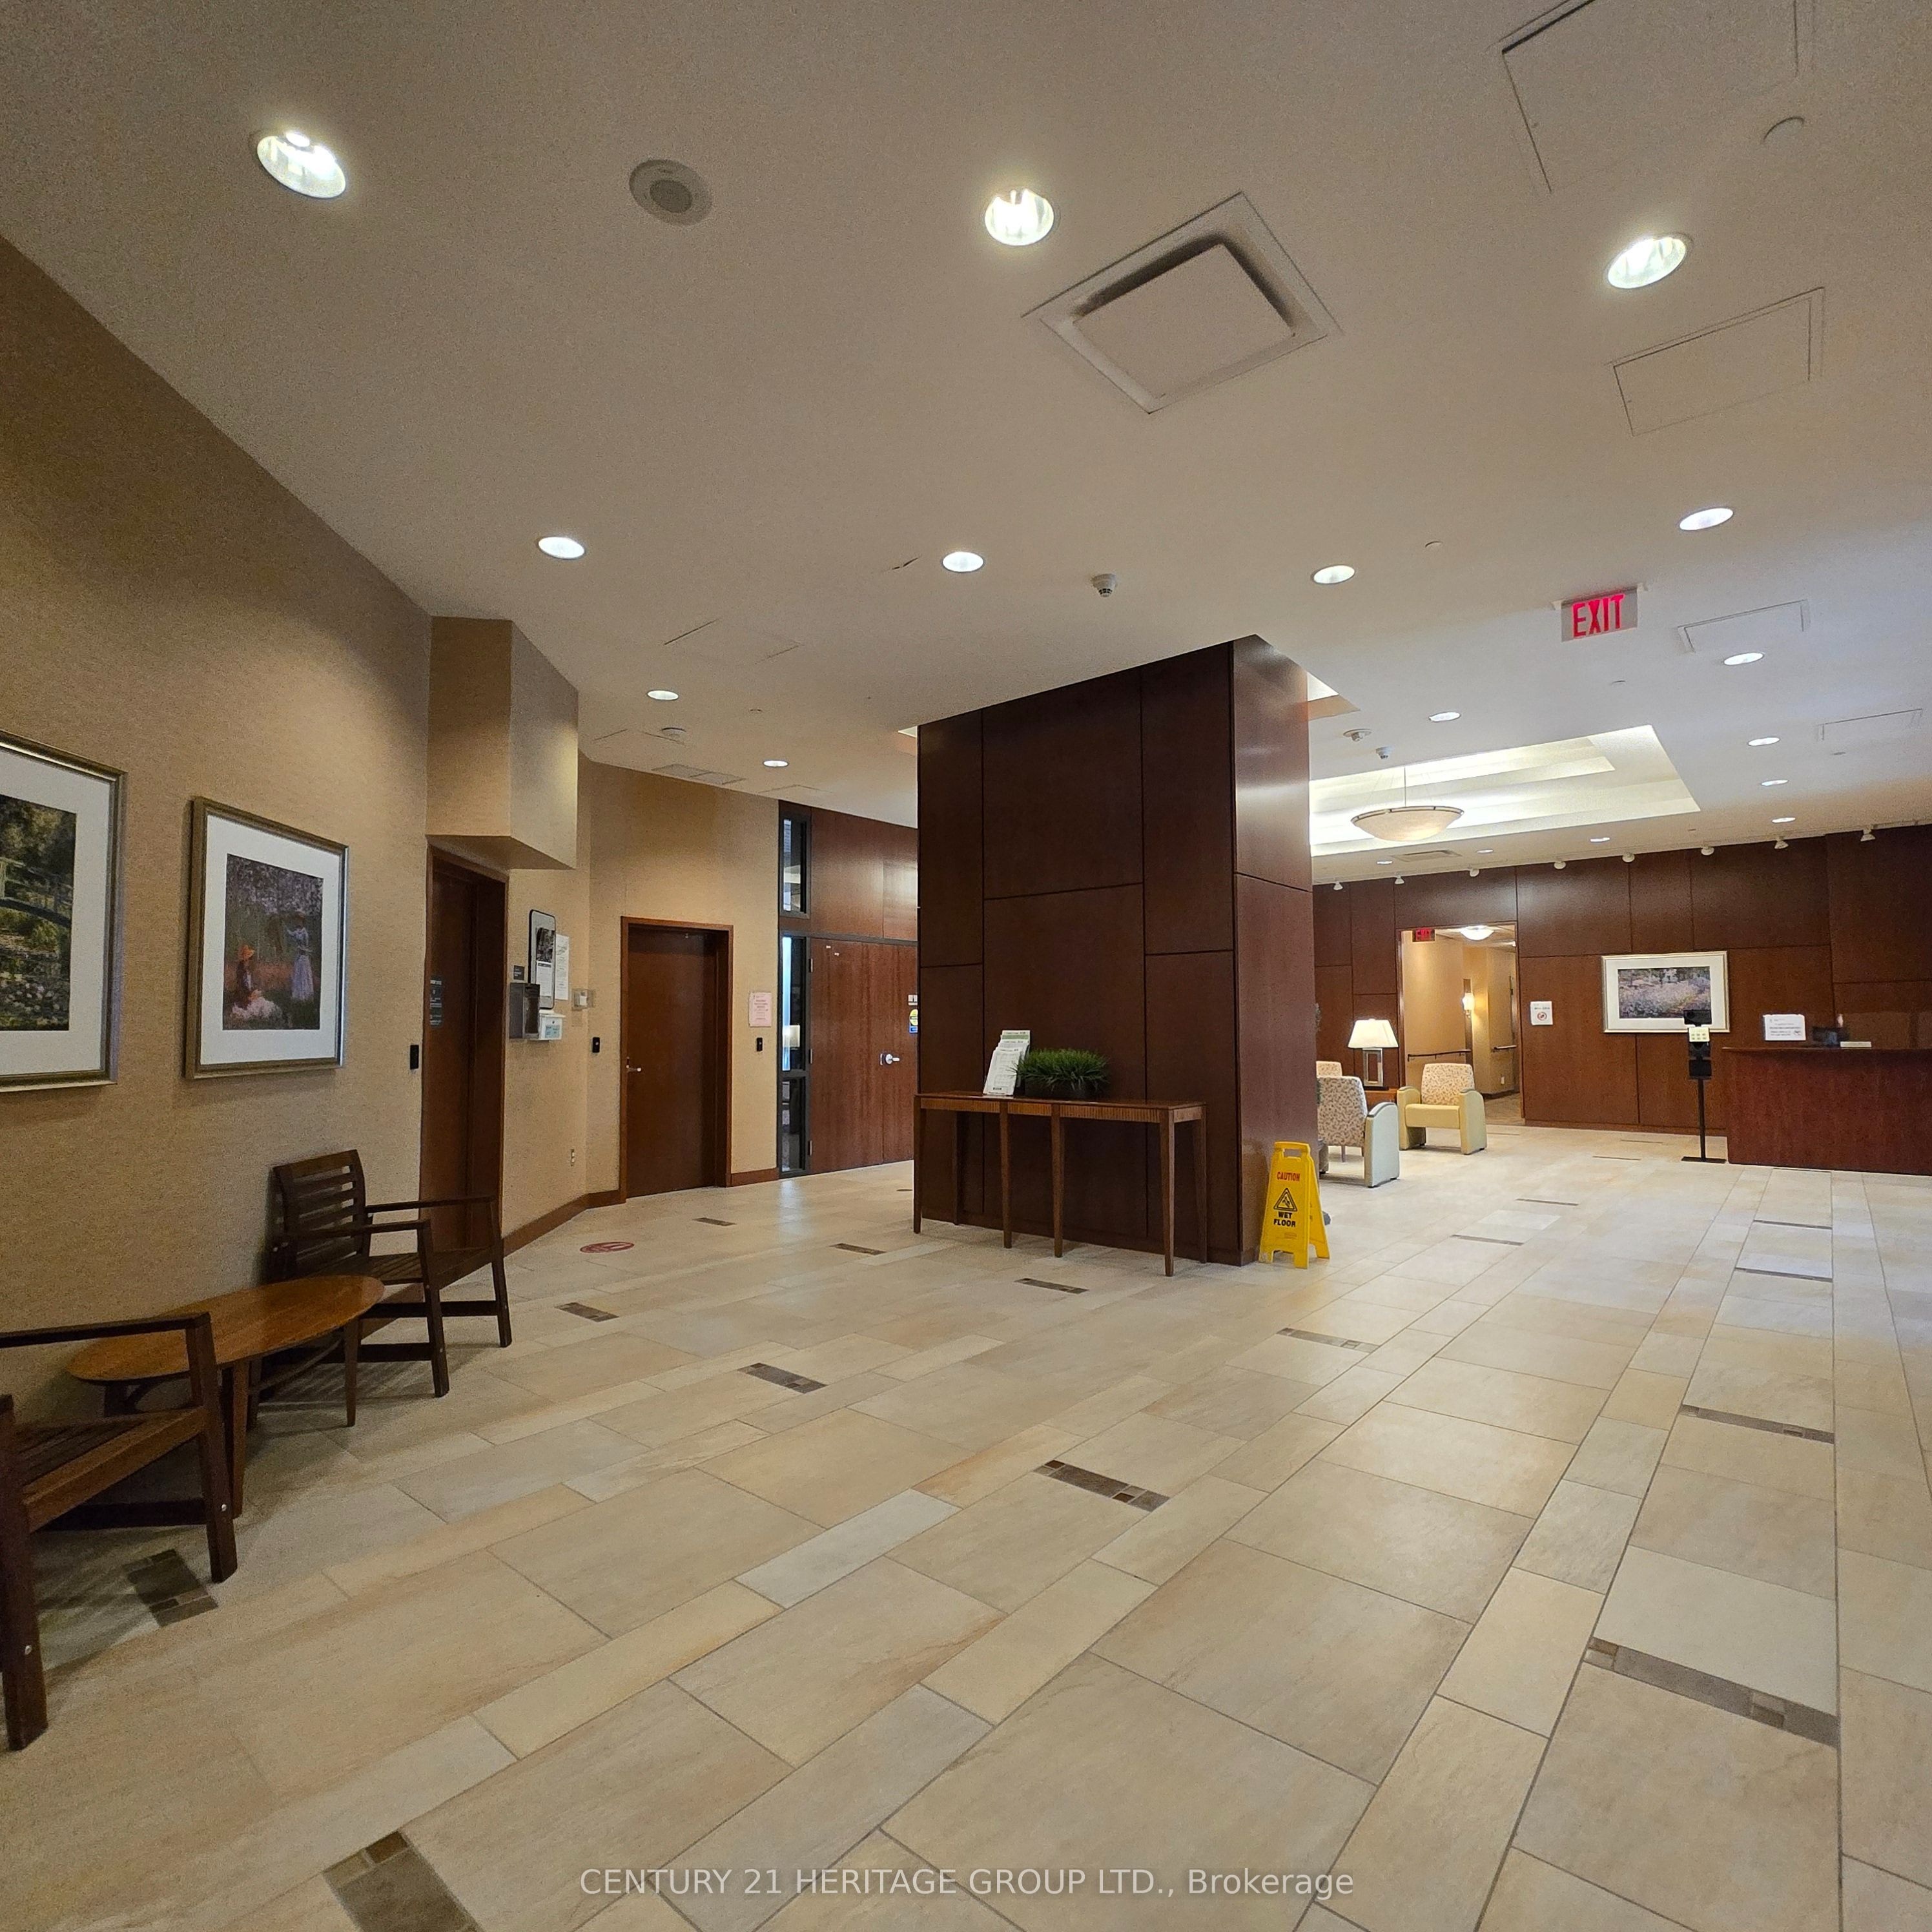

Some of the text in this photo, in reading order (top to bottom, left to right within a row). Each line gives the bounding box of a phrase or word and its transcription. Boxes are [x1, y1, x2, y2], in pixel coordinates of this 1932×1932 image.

[1572, 594, 1625, 637] EXIT
[1277, 1171, 1300, 1182] CAUTION
[1278, 1211, 1293, 1219] WET
[1273, 1218, 1296, 1228] FLOOR
